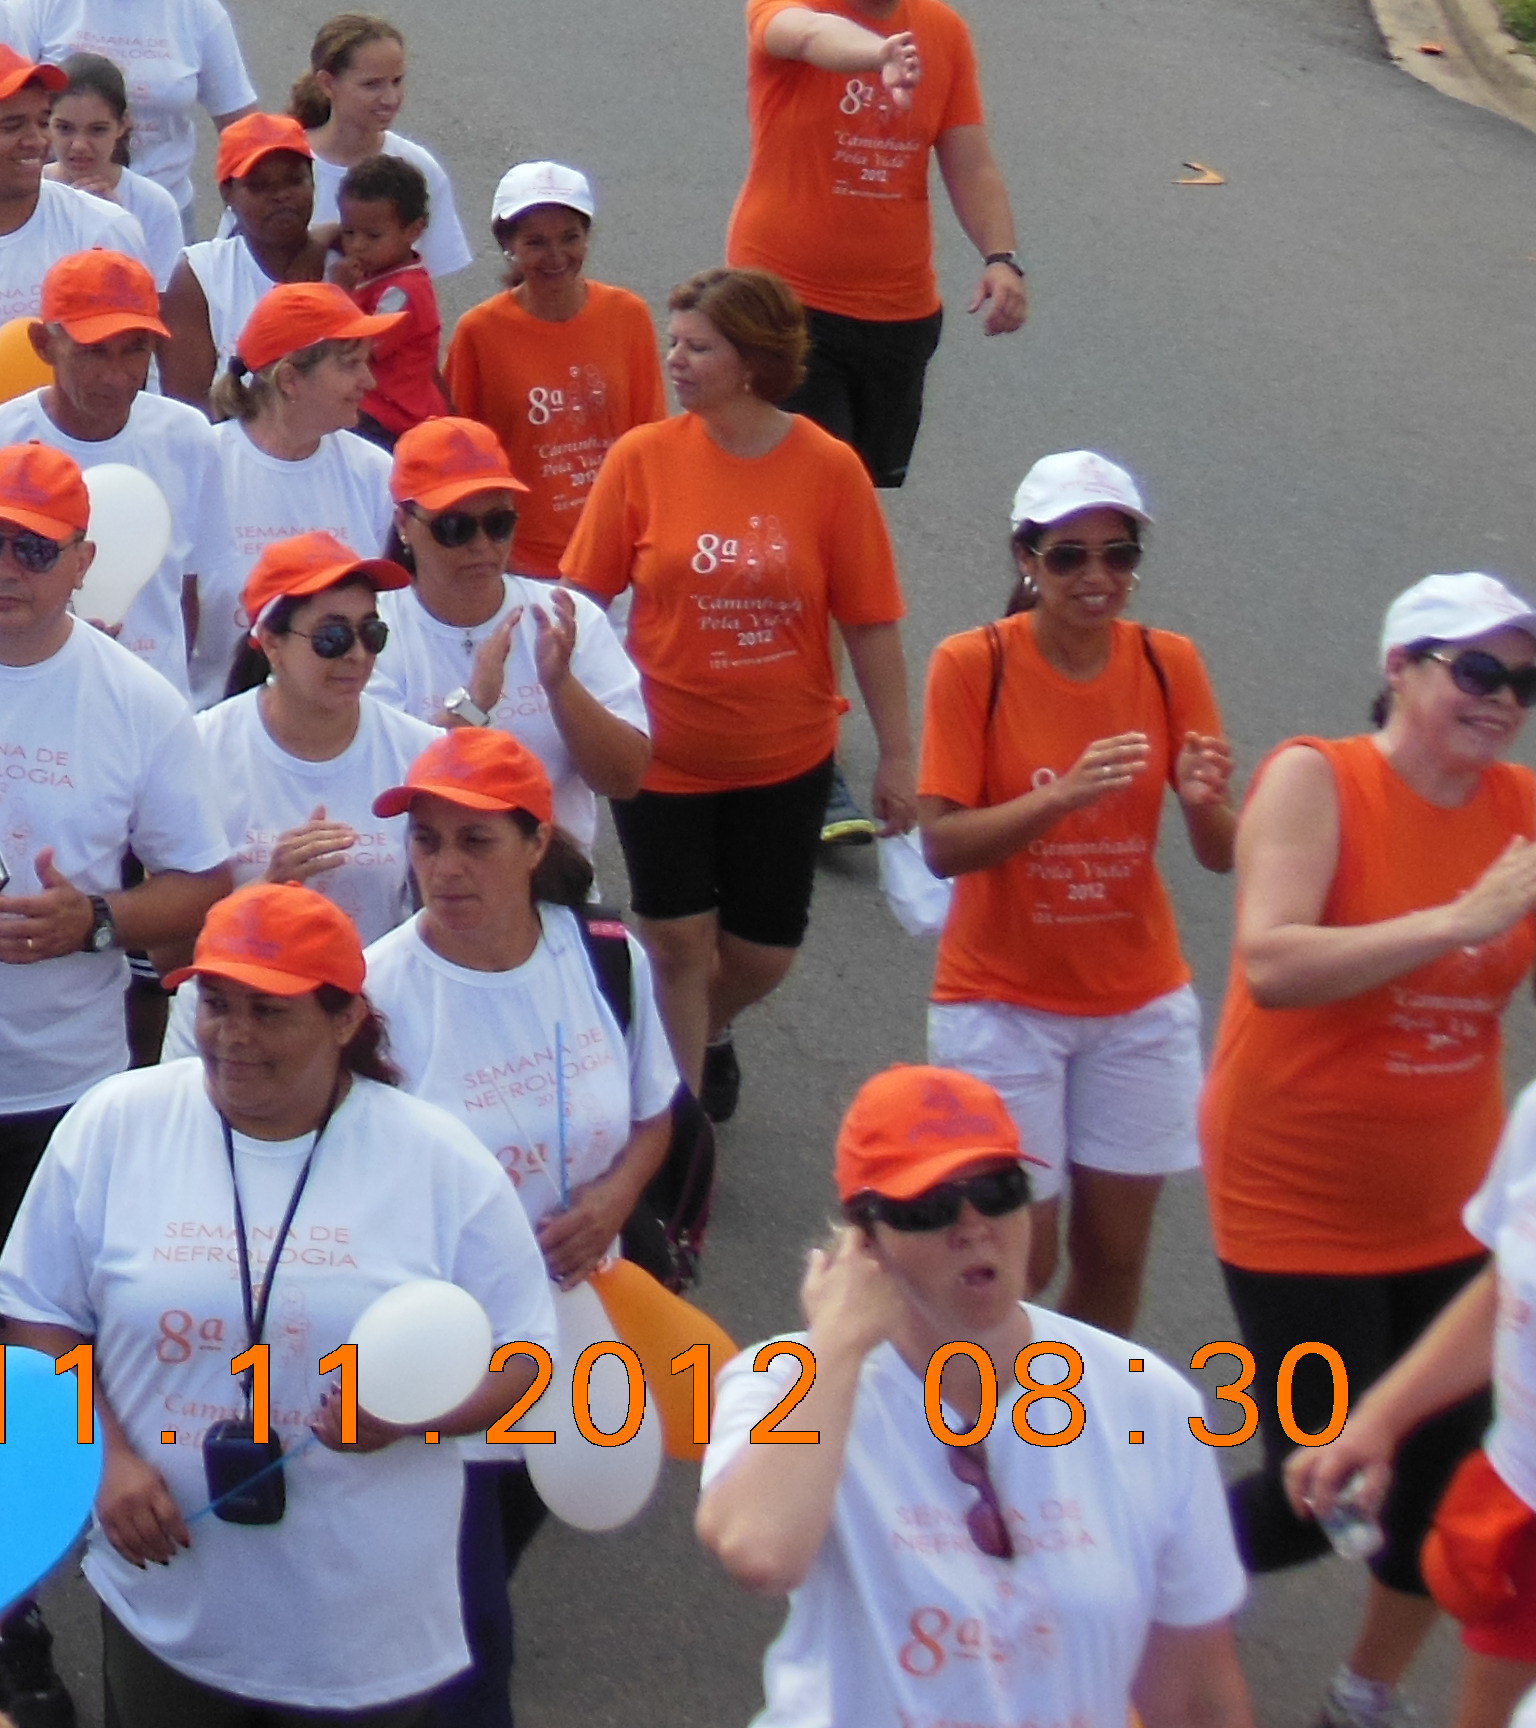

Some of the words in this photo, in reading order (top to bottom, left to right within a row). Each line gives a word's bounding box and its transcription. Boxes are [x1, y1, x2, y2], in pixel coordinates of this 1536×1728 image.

[839, 79, 874, 114] 8ª
[860, 168, 888, 182] 2012
[528, 387, 564, 426] 8ª
[691, 533, 739, 574] 8ª
[737, 630, 774, 646] 2012
[35, 745, 70, 768] DE
[1067, 882, 1107, 901] 2012
[573, 1027, 603, 1049] DE
[308, 1225, 350, 1244] DE
[155, 1309, 224, 1365] 8ª
[898, 1605, 982, 1678] 8ª
